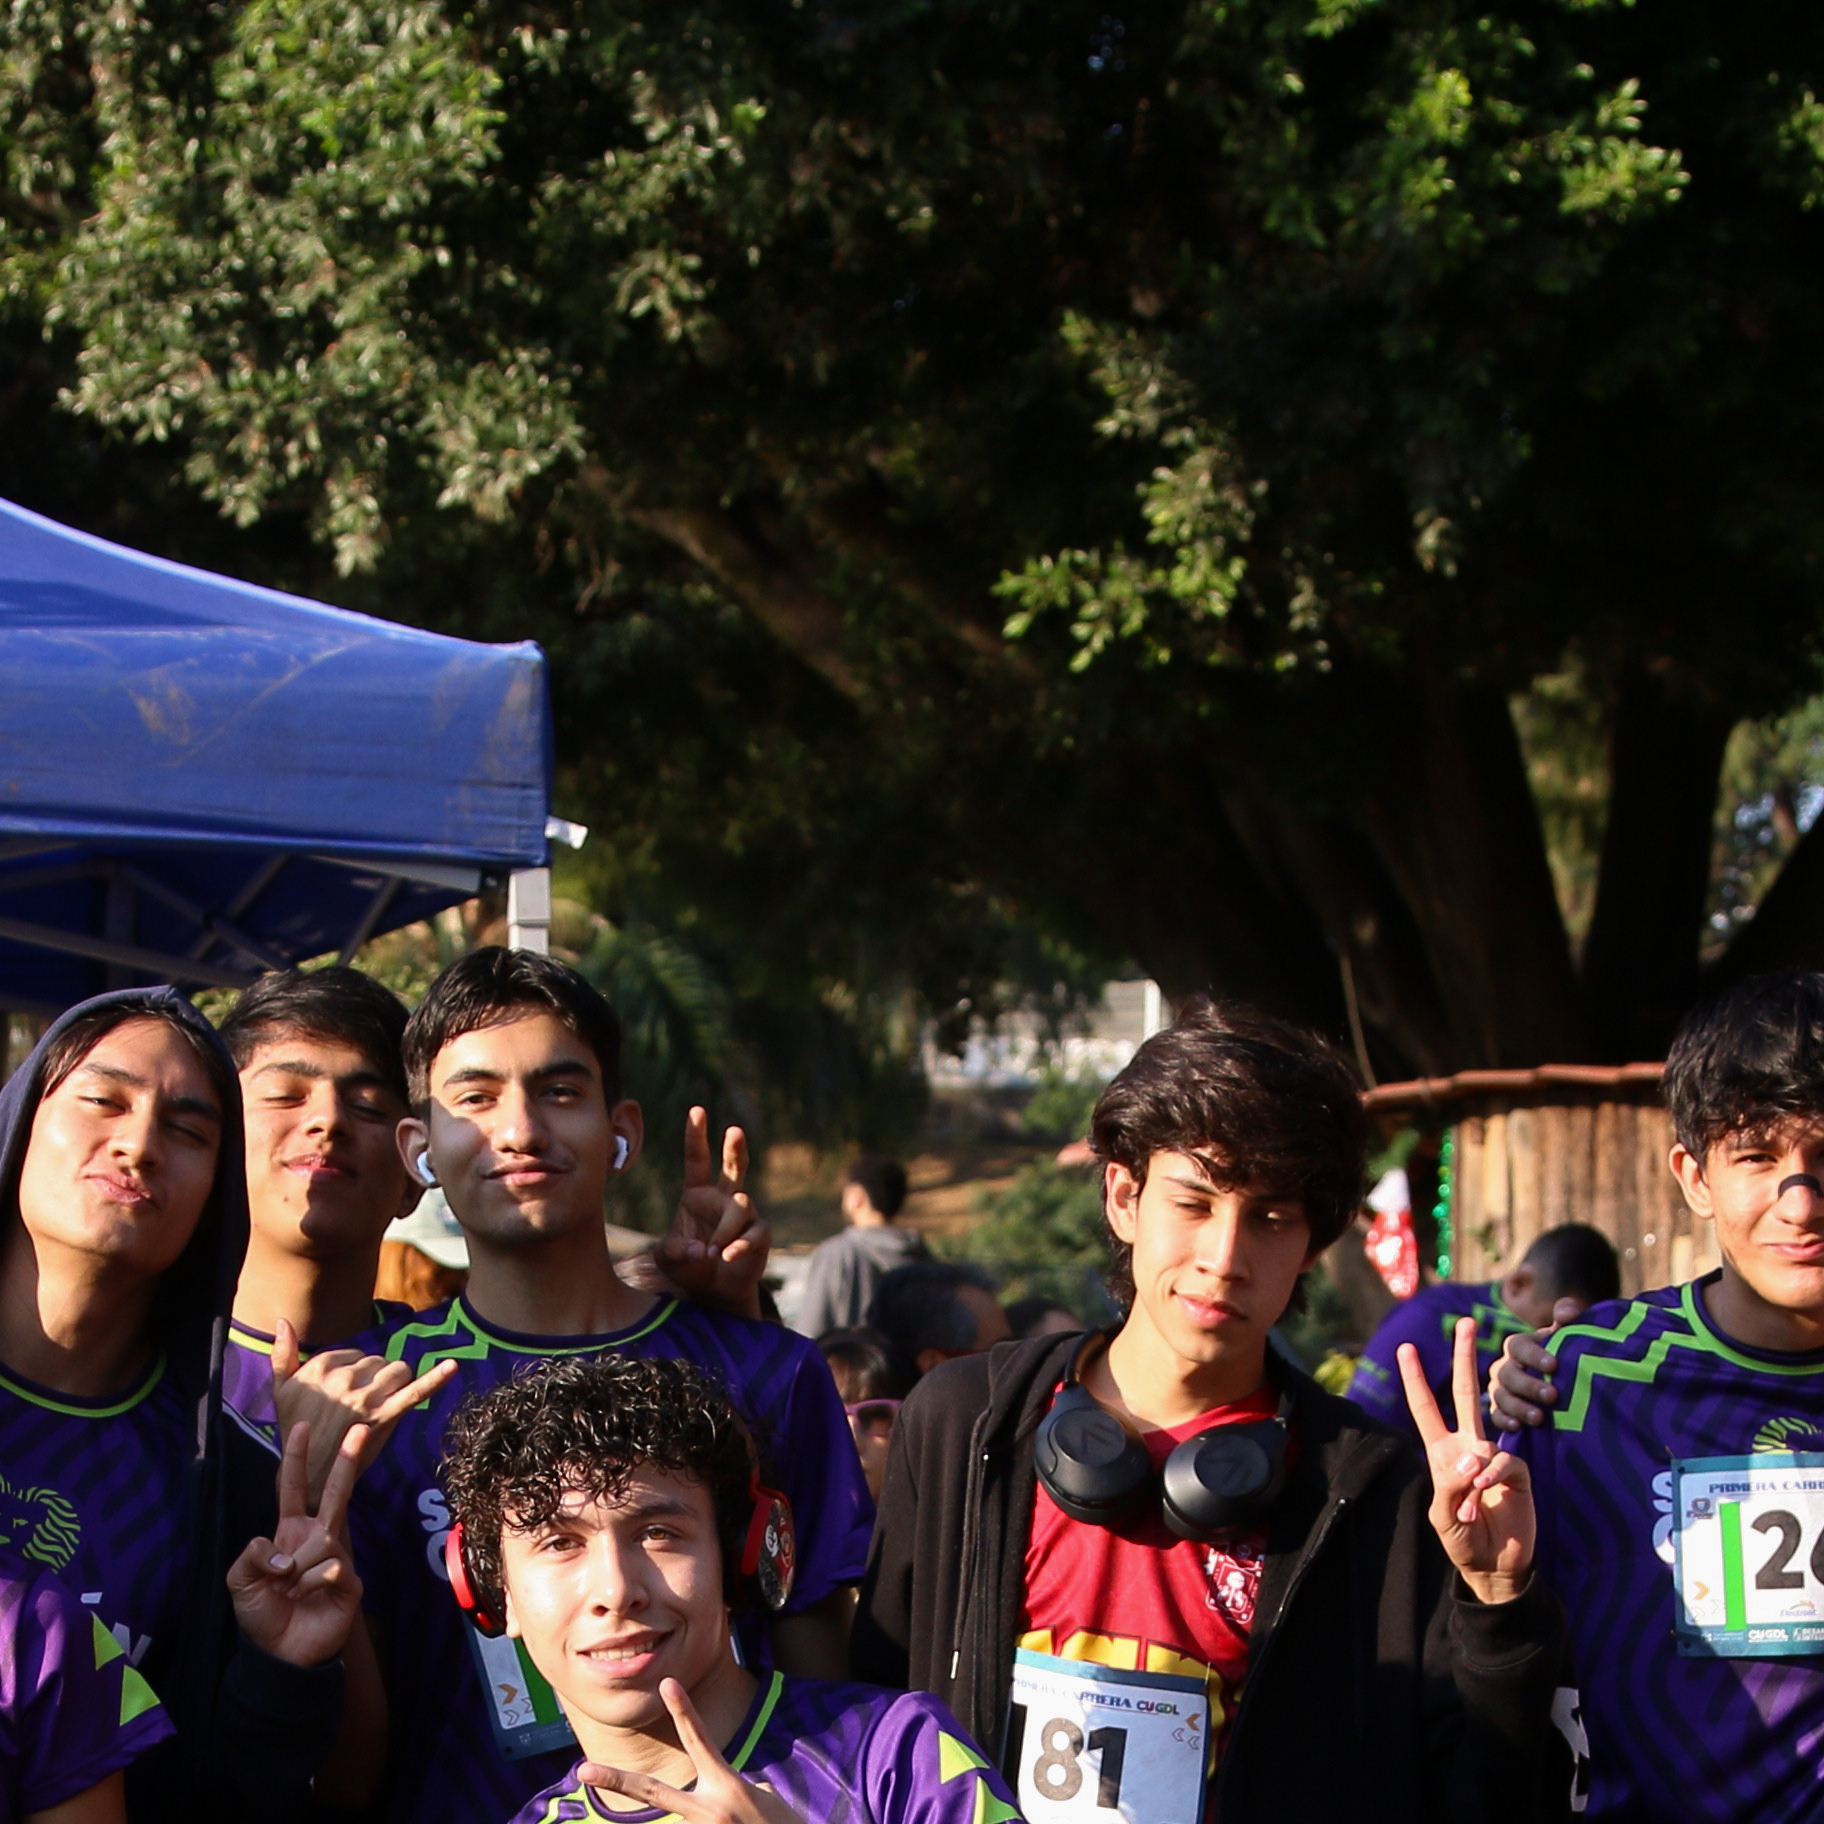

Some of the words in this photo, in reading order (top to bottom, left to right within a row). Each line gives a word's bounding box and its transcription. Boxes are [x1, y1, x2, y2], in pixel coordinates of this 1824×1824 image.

[1709, 1481, 1778, 1494] PRIMERA
[1136, 1700, 1180, 1715] CUGDL
[1033, 1717, 1129, 1810] 81
